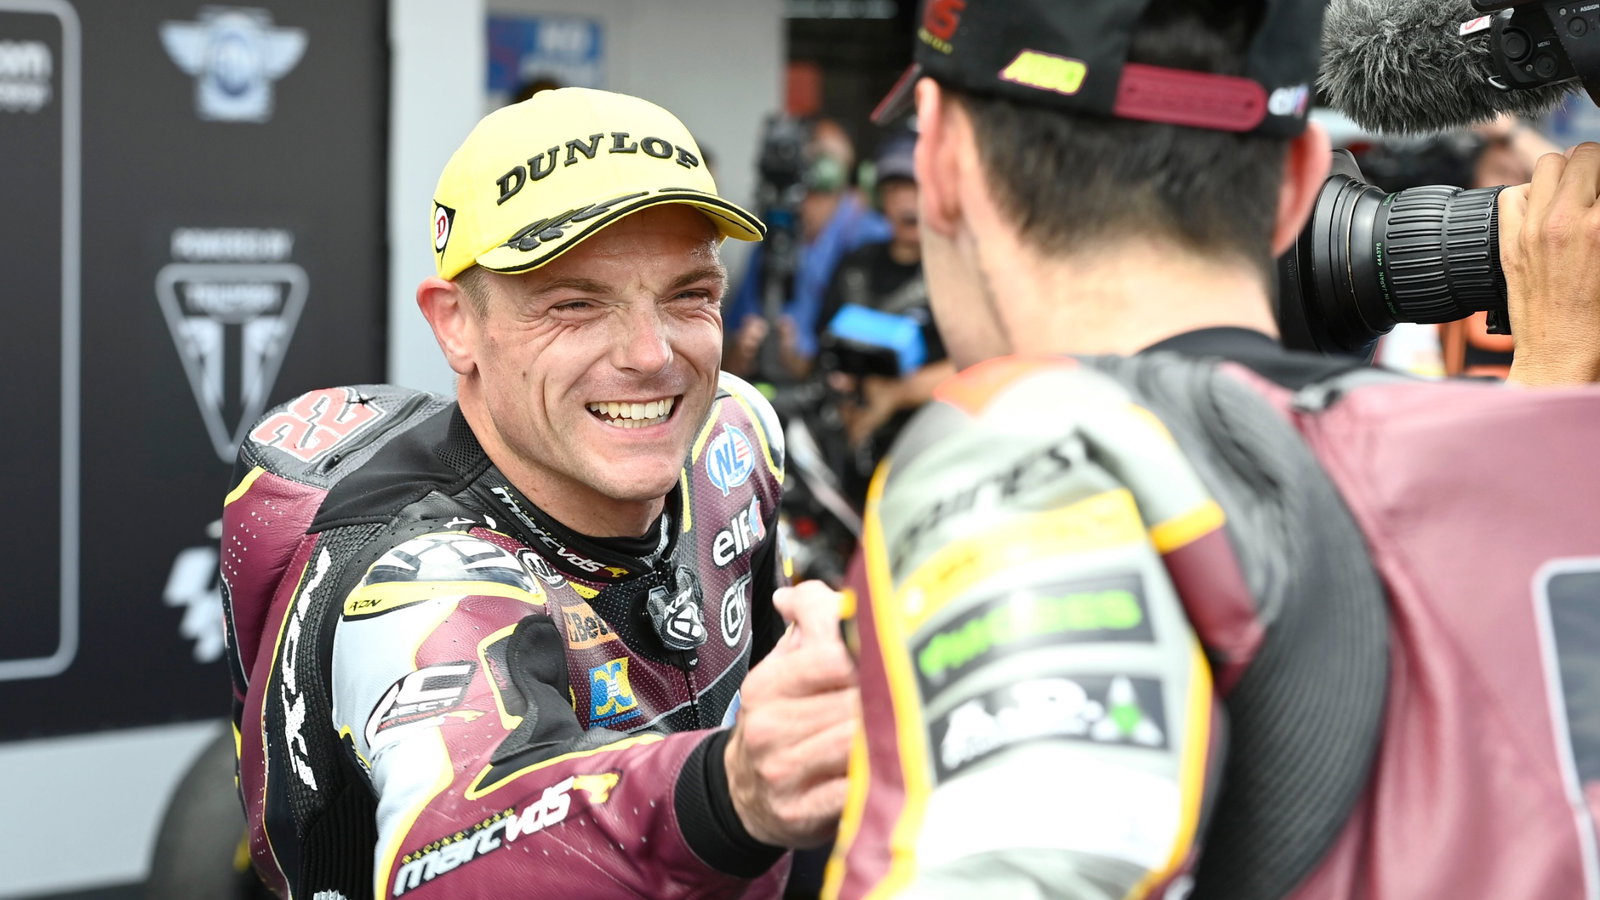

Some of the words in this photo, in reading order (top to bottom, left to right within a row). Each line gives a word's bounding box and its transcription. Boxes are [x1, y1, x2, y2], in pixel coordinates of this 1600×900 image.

[496, 131, 699, 206] DUNLOP
[436, 214, 447, 240] D
[250, 386, 387, 464] 22
[712, 508, 751, 568] elf
